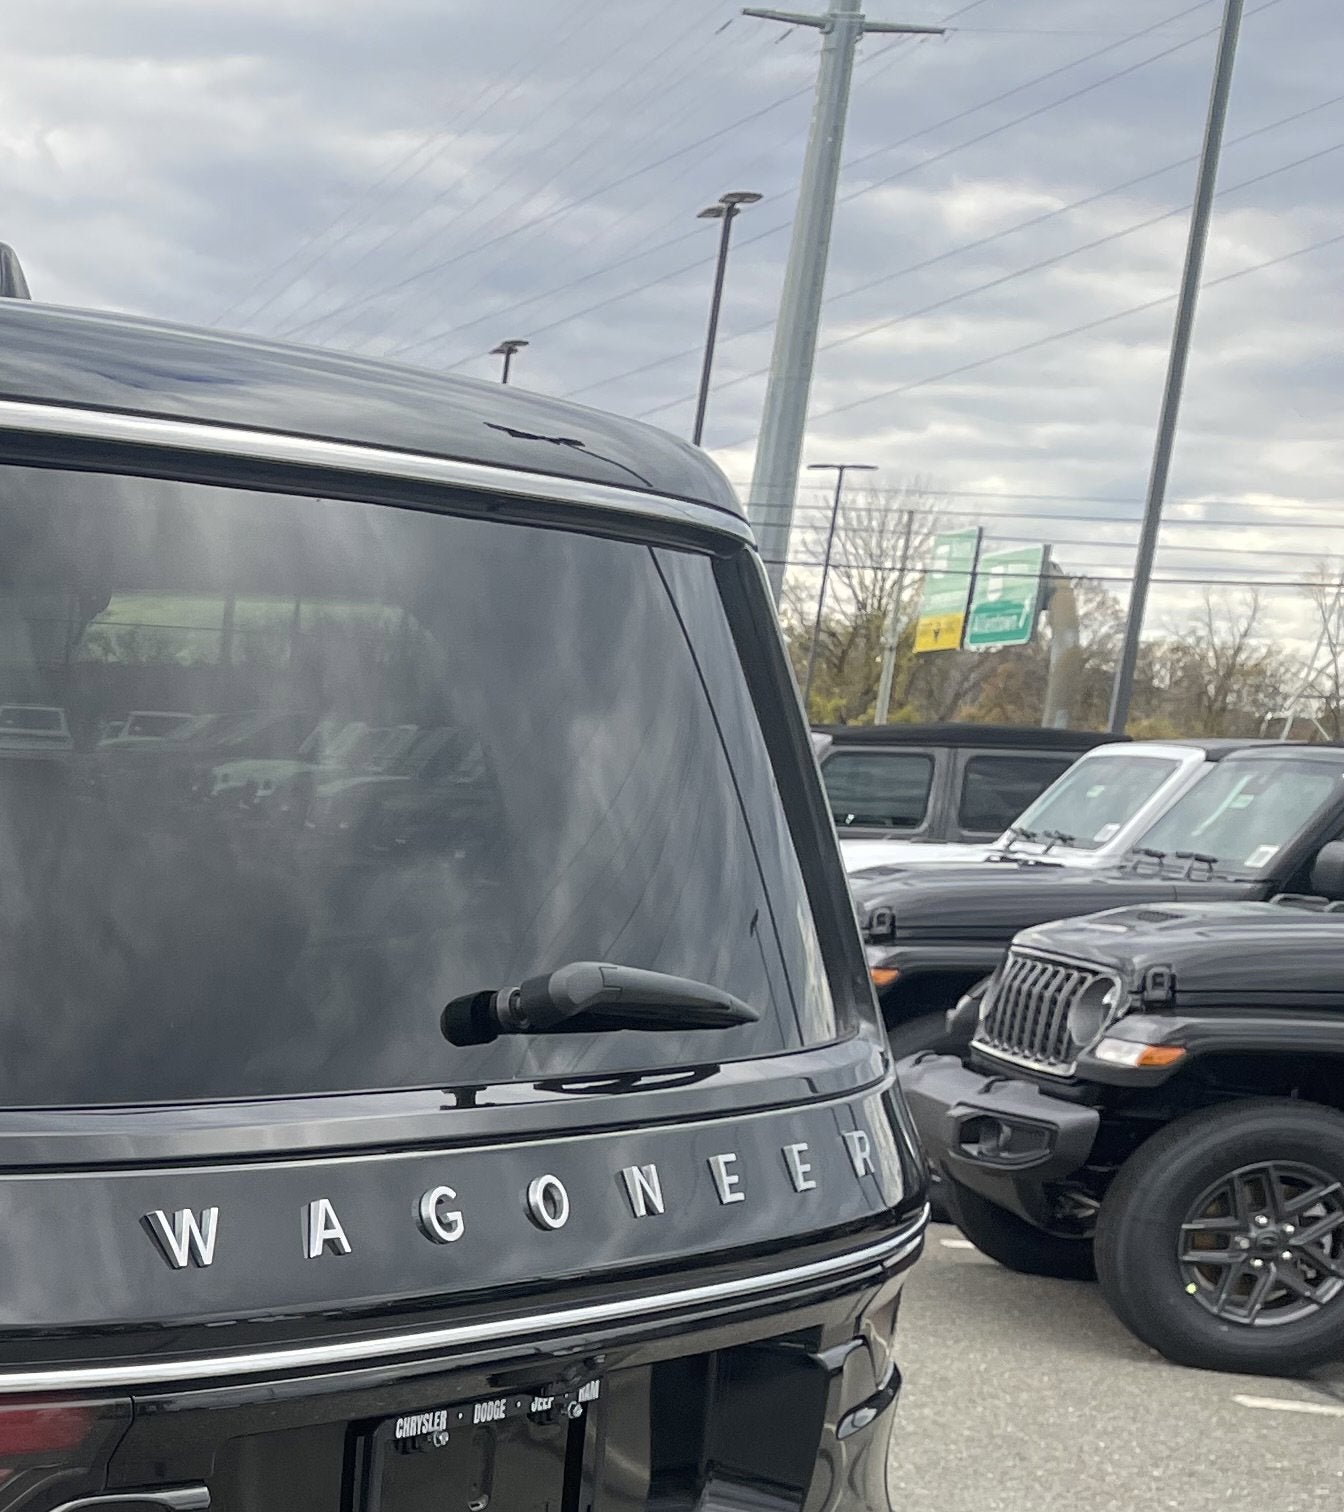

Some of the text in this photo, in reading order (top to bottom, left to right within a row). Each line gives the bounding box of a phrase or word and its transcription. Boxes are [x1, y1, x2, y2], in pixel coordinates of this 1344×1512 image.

[144, 1129, 876, 1270] WAGONEER
[395, 1410, 448, 1439] CHRYSLER
[473, 1399, 507, 1424] DODGE
